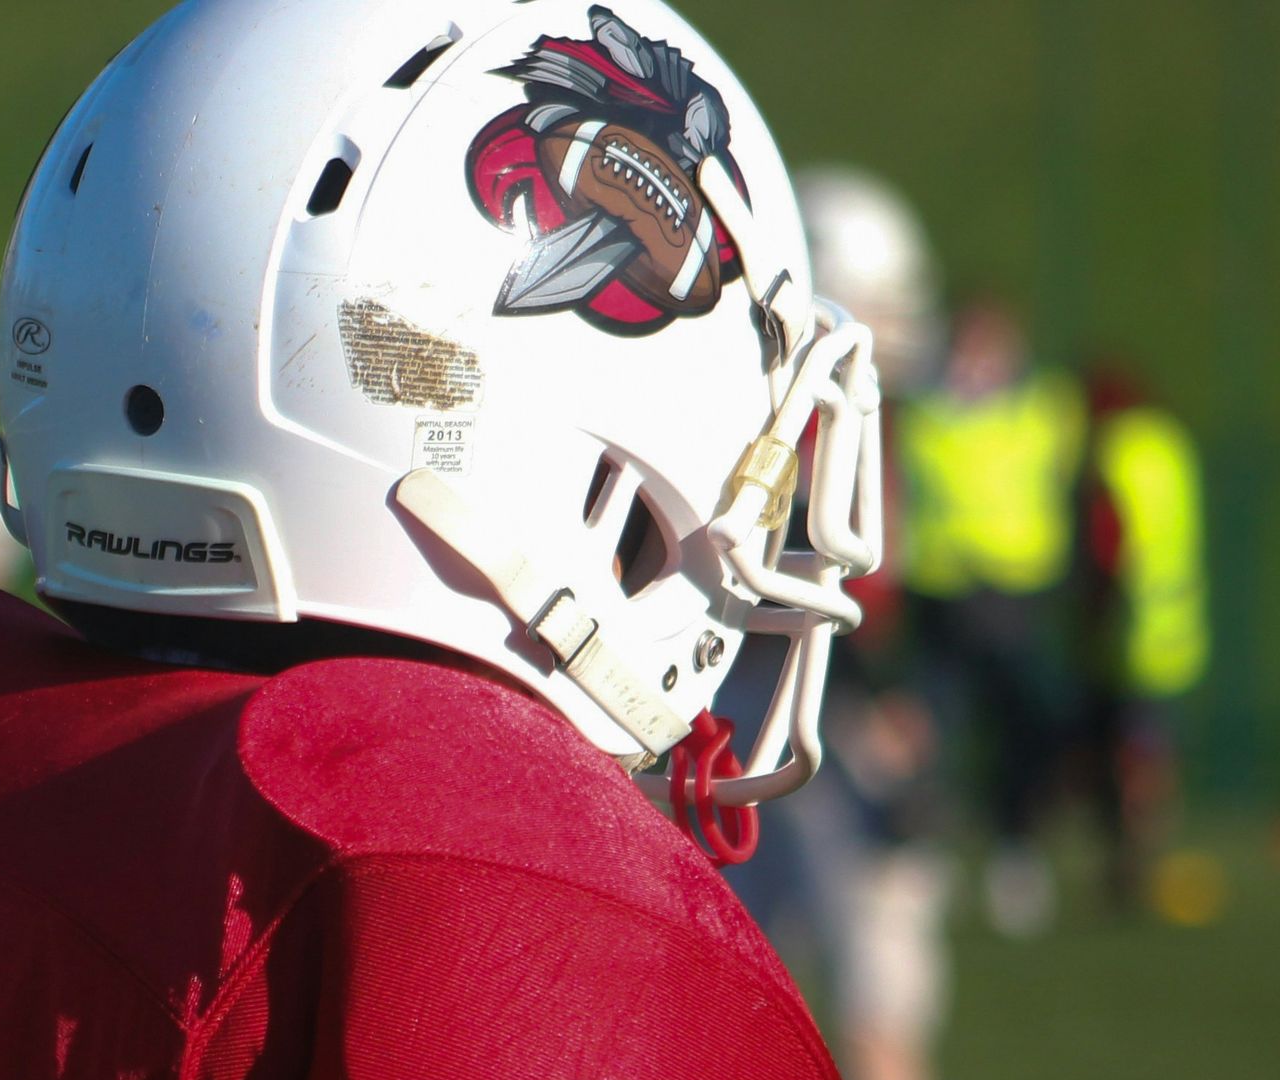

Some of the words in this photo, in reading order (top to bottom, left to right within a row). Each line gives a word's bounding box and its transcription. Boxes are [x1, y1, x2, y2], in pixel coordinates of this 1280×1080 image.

[444, 420, 473, 428] SEASON
[427, 430, 462, 441] 2013
[64, 521, 237, 564] RAWLINGS
